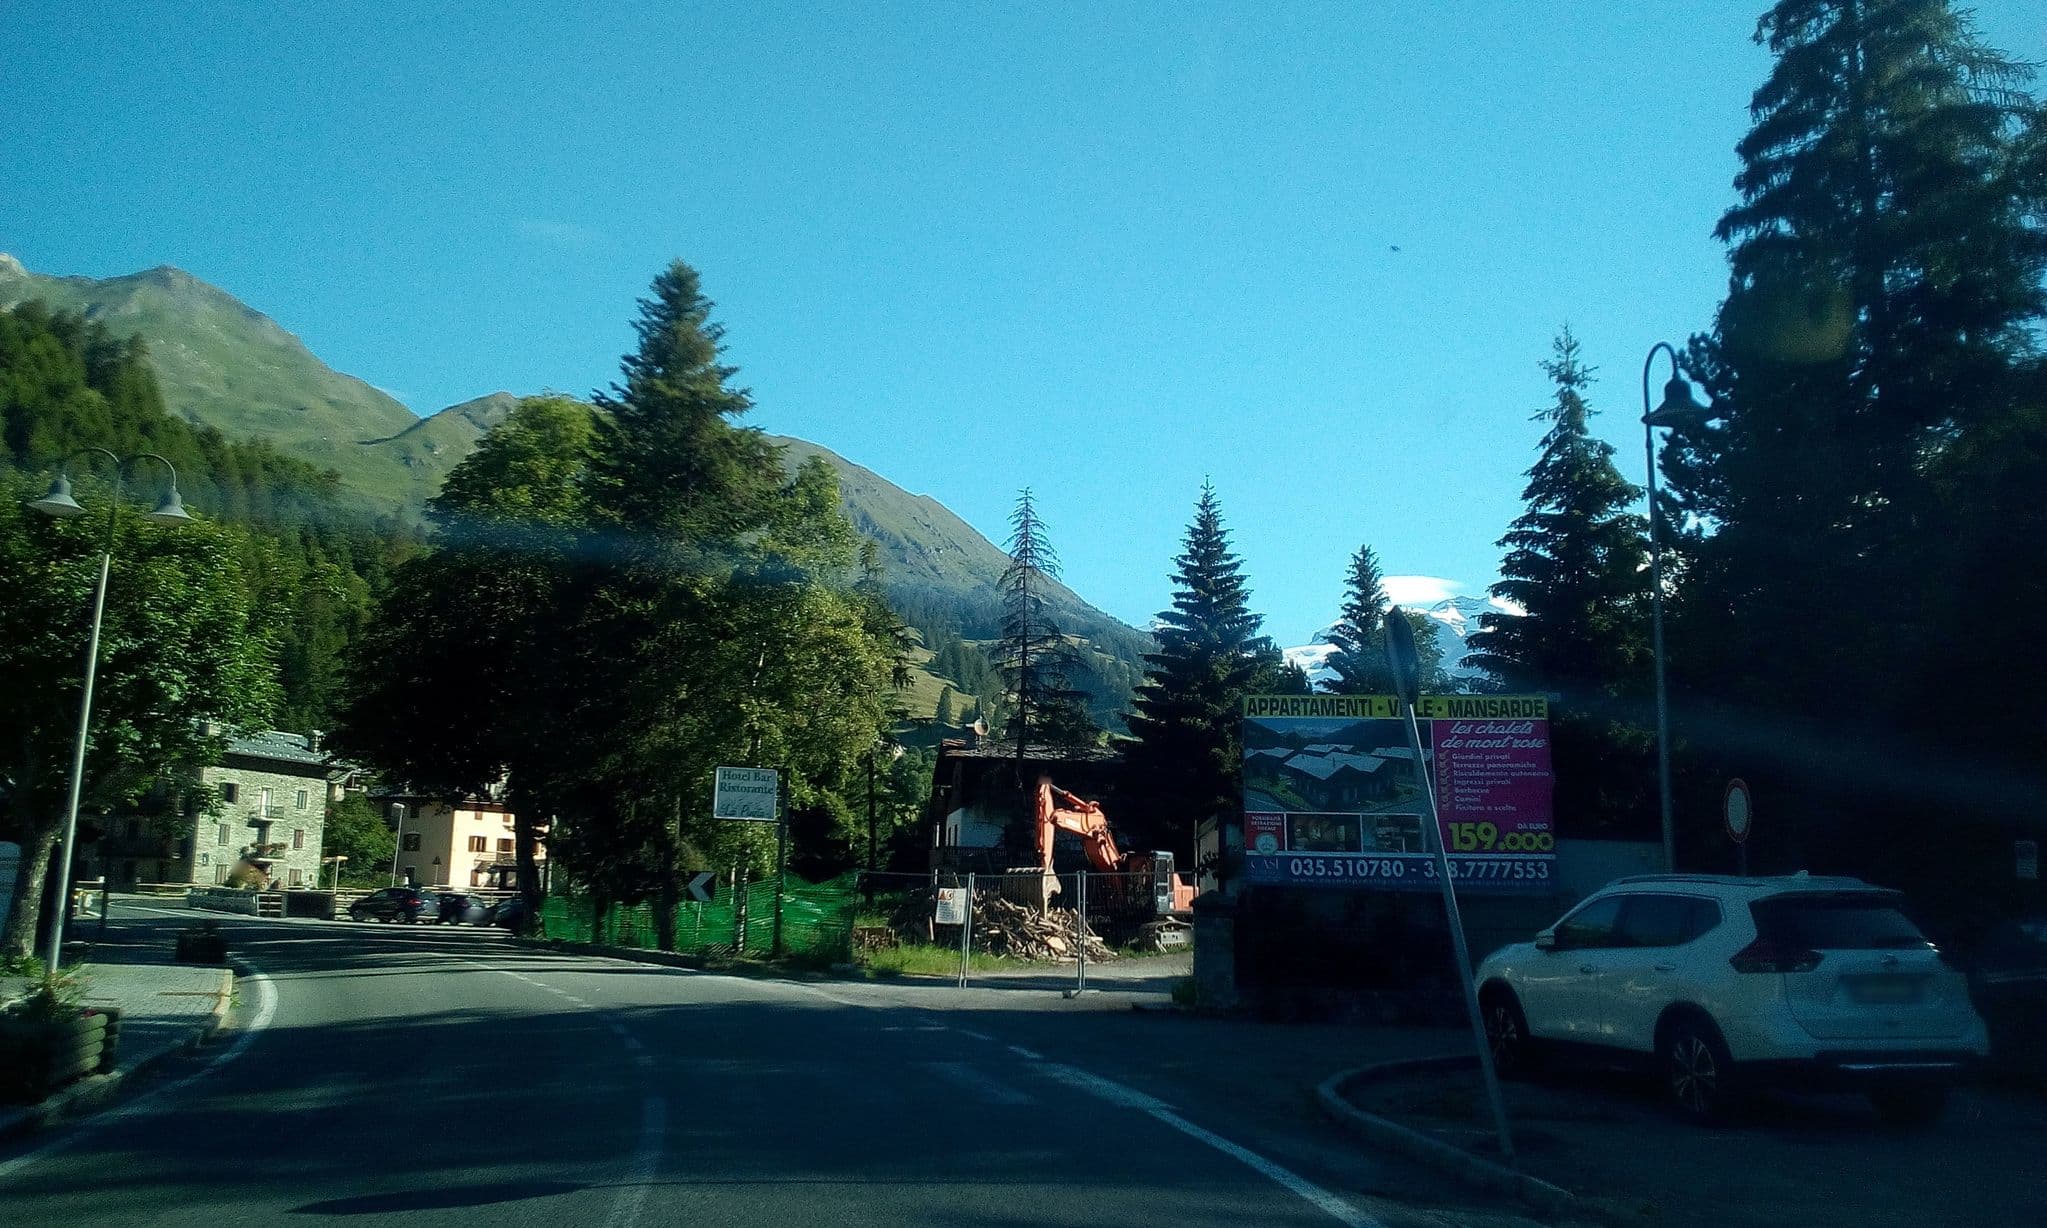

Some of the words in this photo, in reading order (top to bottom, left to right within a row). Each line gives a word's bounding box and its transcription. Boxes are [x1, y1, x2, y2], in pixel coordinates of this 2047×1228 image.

[1247, 698, 1372, 717] APPARTAMENTI
[1448, 699, 1545, 718] MANSARDE
[1450, 721, 1474, 734] les
[1475, 721, 1534, 734] chalets
[1440, 734, 1464, 748] de
[1465, 735, 1514, 749] mont
[1511, 737, 1547, 749] rose
[1485, 752, 1511, 761] privati
[723, 770, 751, 781] Hotel
[754, 772, 772, 782] Bar
[720, 782, 774, 795] Ristorante
[1448, 821, 1554, 851] 159.000
[1290, 857, 1405, 878] 035.510780
